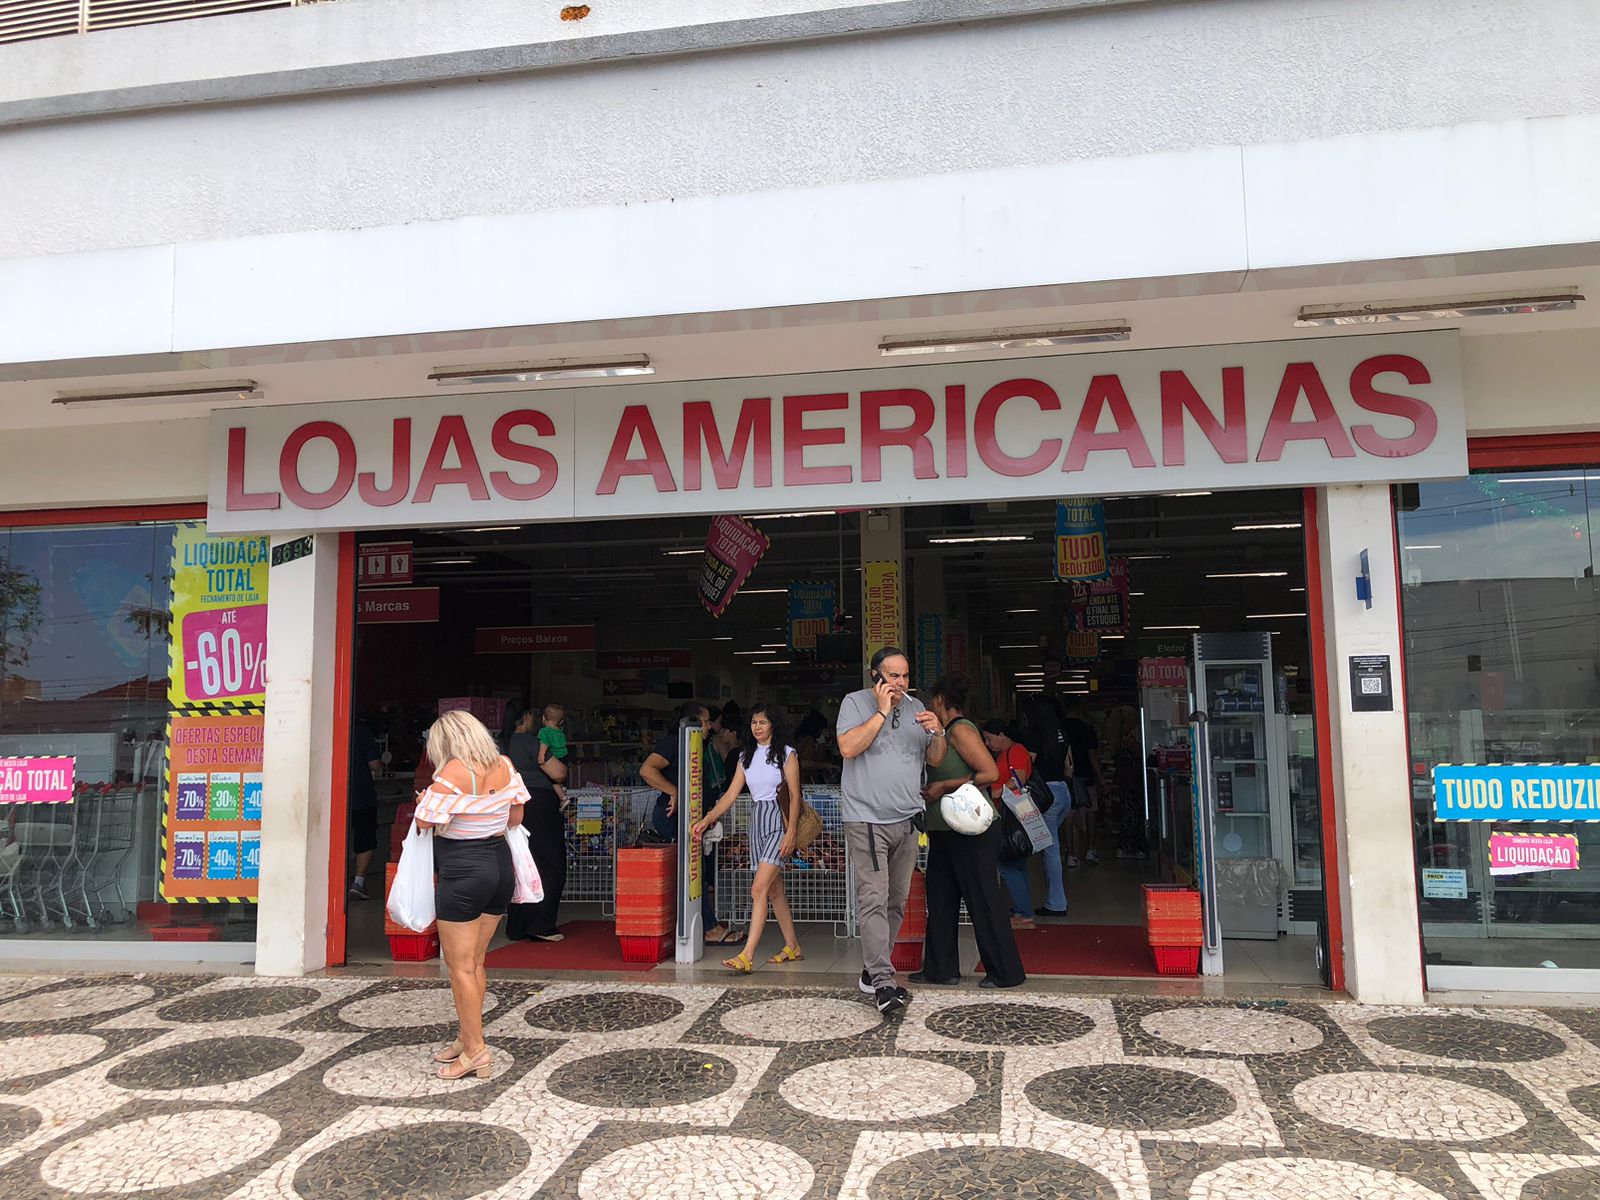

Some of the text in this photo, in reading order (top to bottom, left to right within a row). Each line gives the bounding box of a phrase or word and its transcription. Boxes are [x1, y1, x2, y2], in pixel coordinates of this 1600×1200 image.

[226, 354, 1438, 511] LOJAS AMERICANAS
[1067, 508, 1094, 521] TOTAL
[715, 535, 741, 560] TOTAL
[1061, 535, 1100, 560] TUDO
[1060, 558, 1105, 576] REDUZIDO!
[206, 568, 254, 592] TOTAL
[882, 571, 895, 601] VENDA
[200, 593, 259, 603] FECHAMENTO DE LOJA
[365, 601, 410, 612] Marcas
[222, 609, 236, 624] ATÉ
[868, 587, 882, 643] DO ESTOQUE!
[882, 603, 896, 620] ATÉ
[1087, 613, 1120, 626] ESTOQUE!
[501, 634, 568, 646] Preços Baixos
[175, 727, 220, 744] OFERTAS
[186, 746, 264, 764] DESTA SEMANA
[27, 769, 68, 791] TOTAL
[179, 790, 203, 807] -70%
[212, 790, 237, 807] -30%
[1442, 778, 1503, 809] TUDO
[176, 849, 201, 866] -70%
[210, 849, 235, 866] -40%
[1497, 845, 1570, 866] LIQUIDAÇÃO
